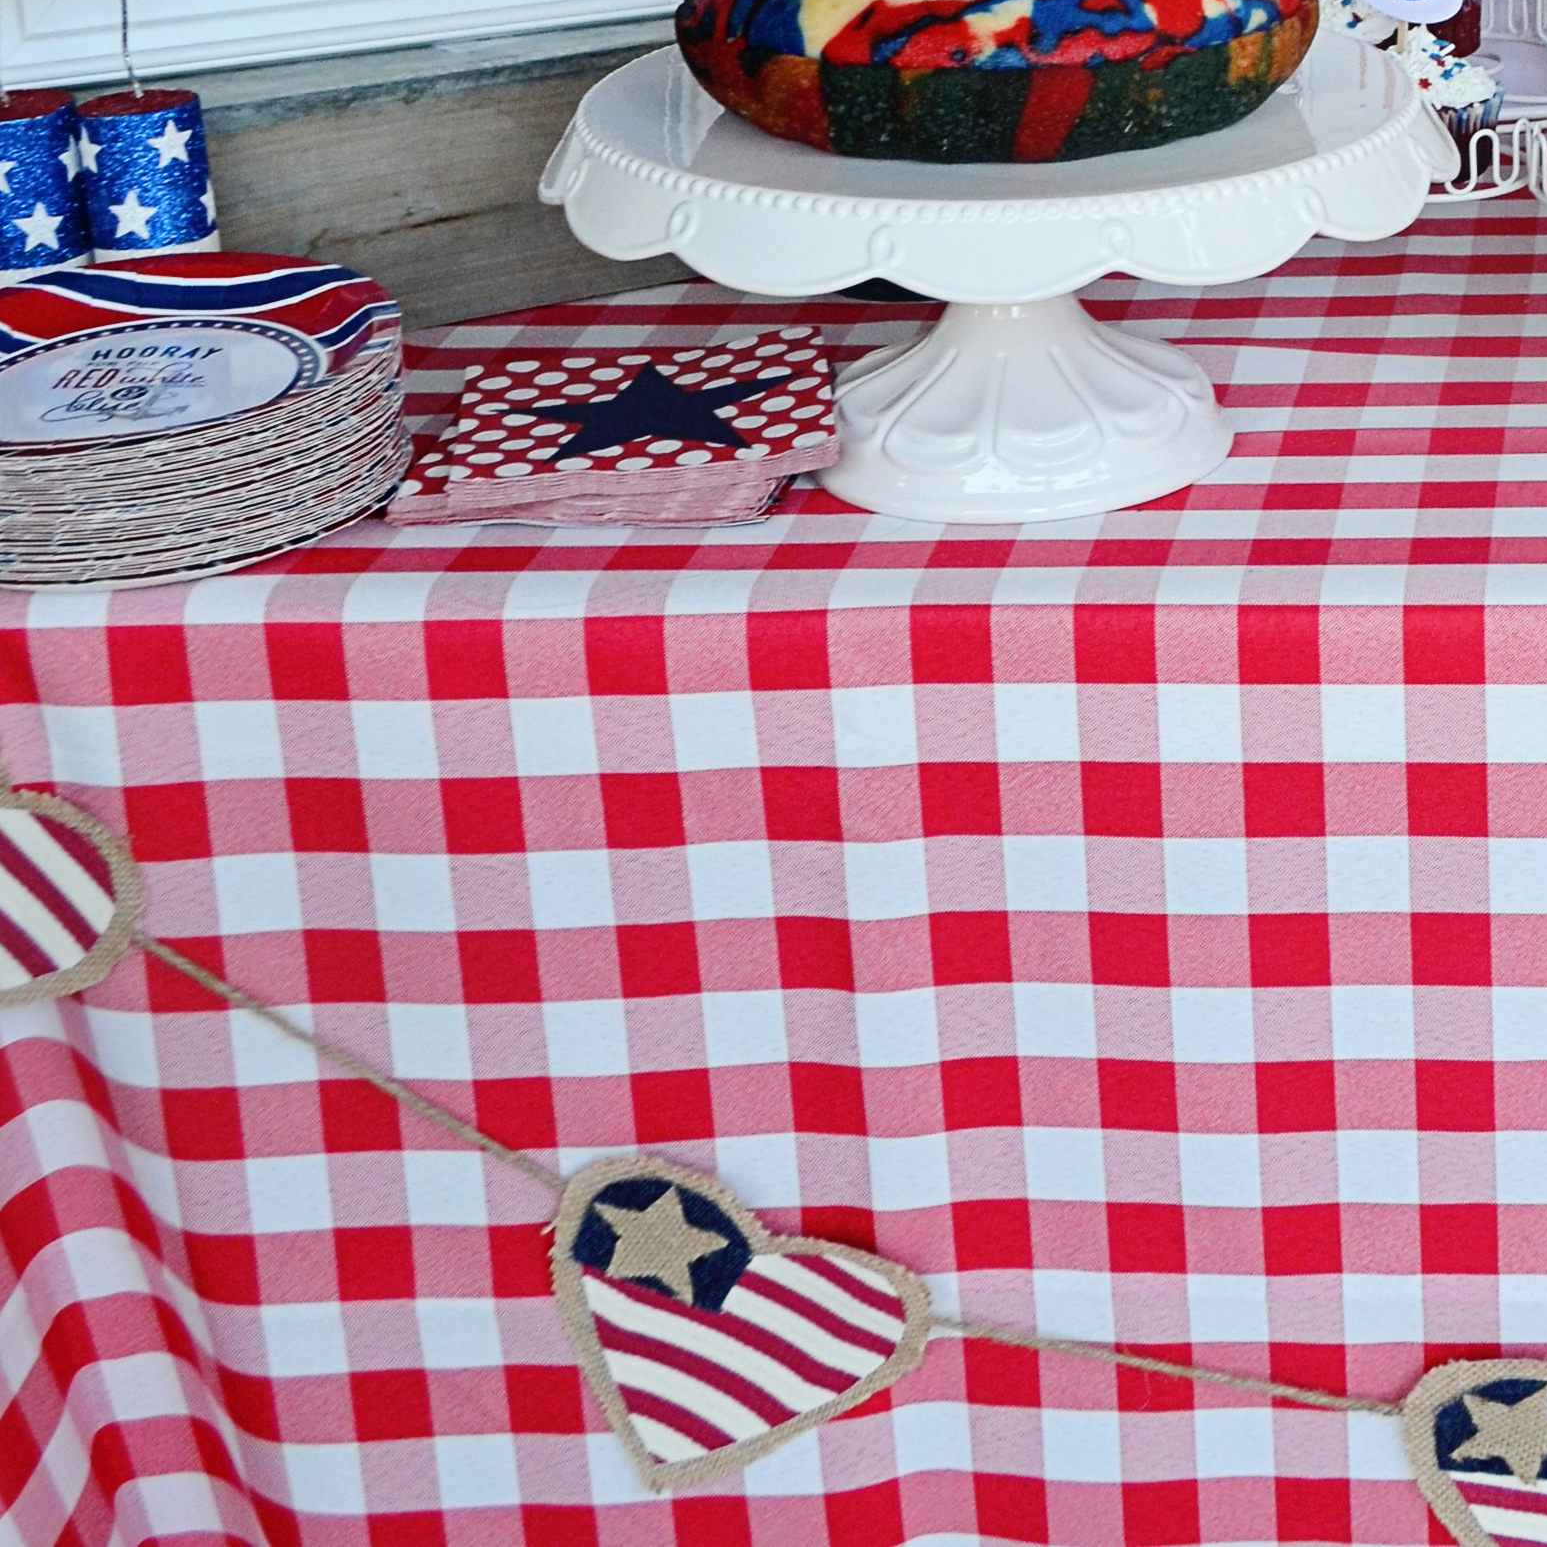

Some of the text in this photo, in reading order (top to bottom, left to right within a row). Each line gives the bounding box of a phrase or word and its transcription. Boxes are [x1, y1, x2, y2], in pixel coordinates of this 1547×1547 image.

[91, 345, 224, 361] HOORAY
[51, 368, 121, 390] RED
[43, 390, 141, 421] blue
